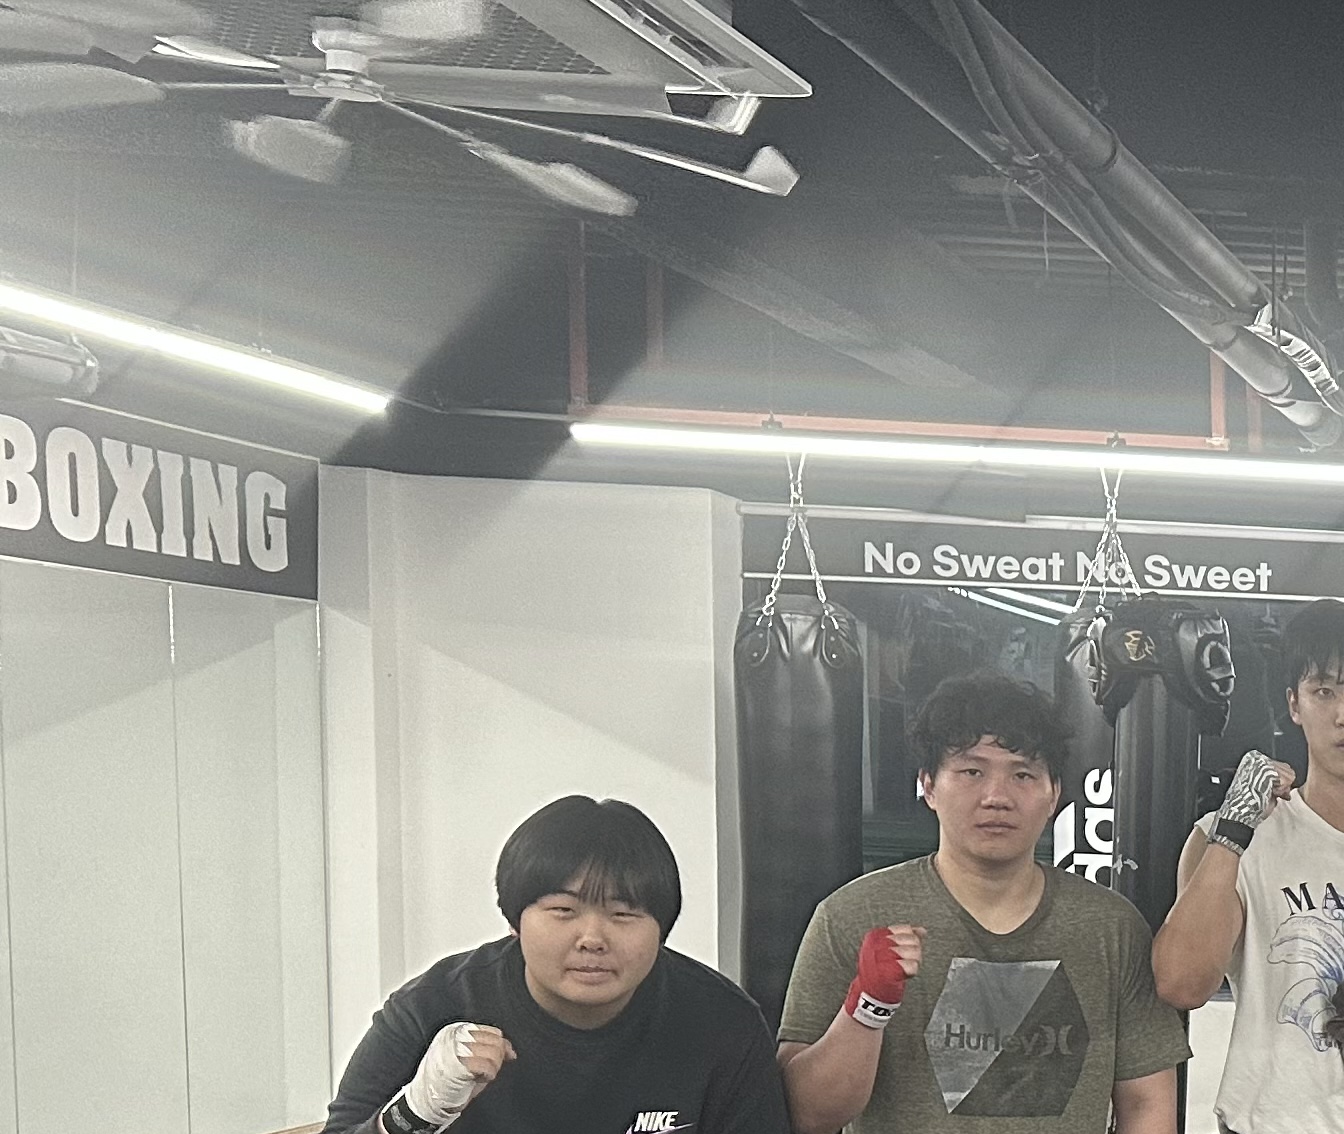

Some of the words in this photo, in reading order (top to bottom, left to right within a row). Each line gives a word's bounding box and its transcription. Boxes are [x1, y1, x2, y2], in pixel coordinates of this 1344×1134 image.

[0, 413, 289, 573] BOXING
[864, 541, 921, 577] No
[932, 544, 1065, 582] Sweat
[1077, 550, 1131, 579] No
[1144, 554, 1273, 592] Sweet
[633, 1111, 679, 1133] NIKE
